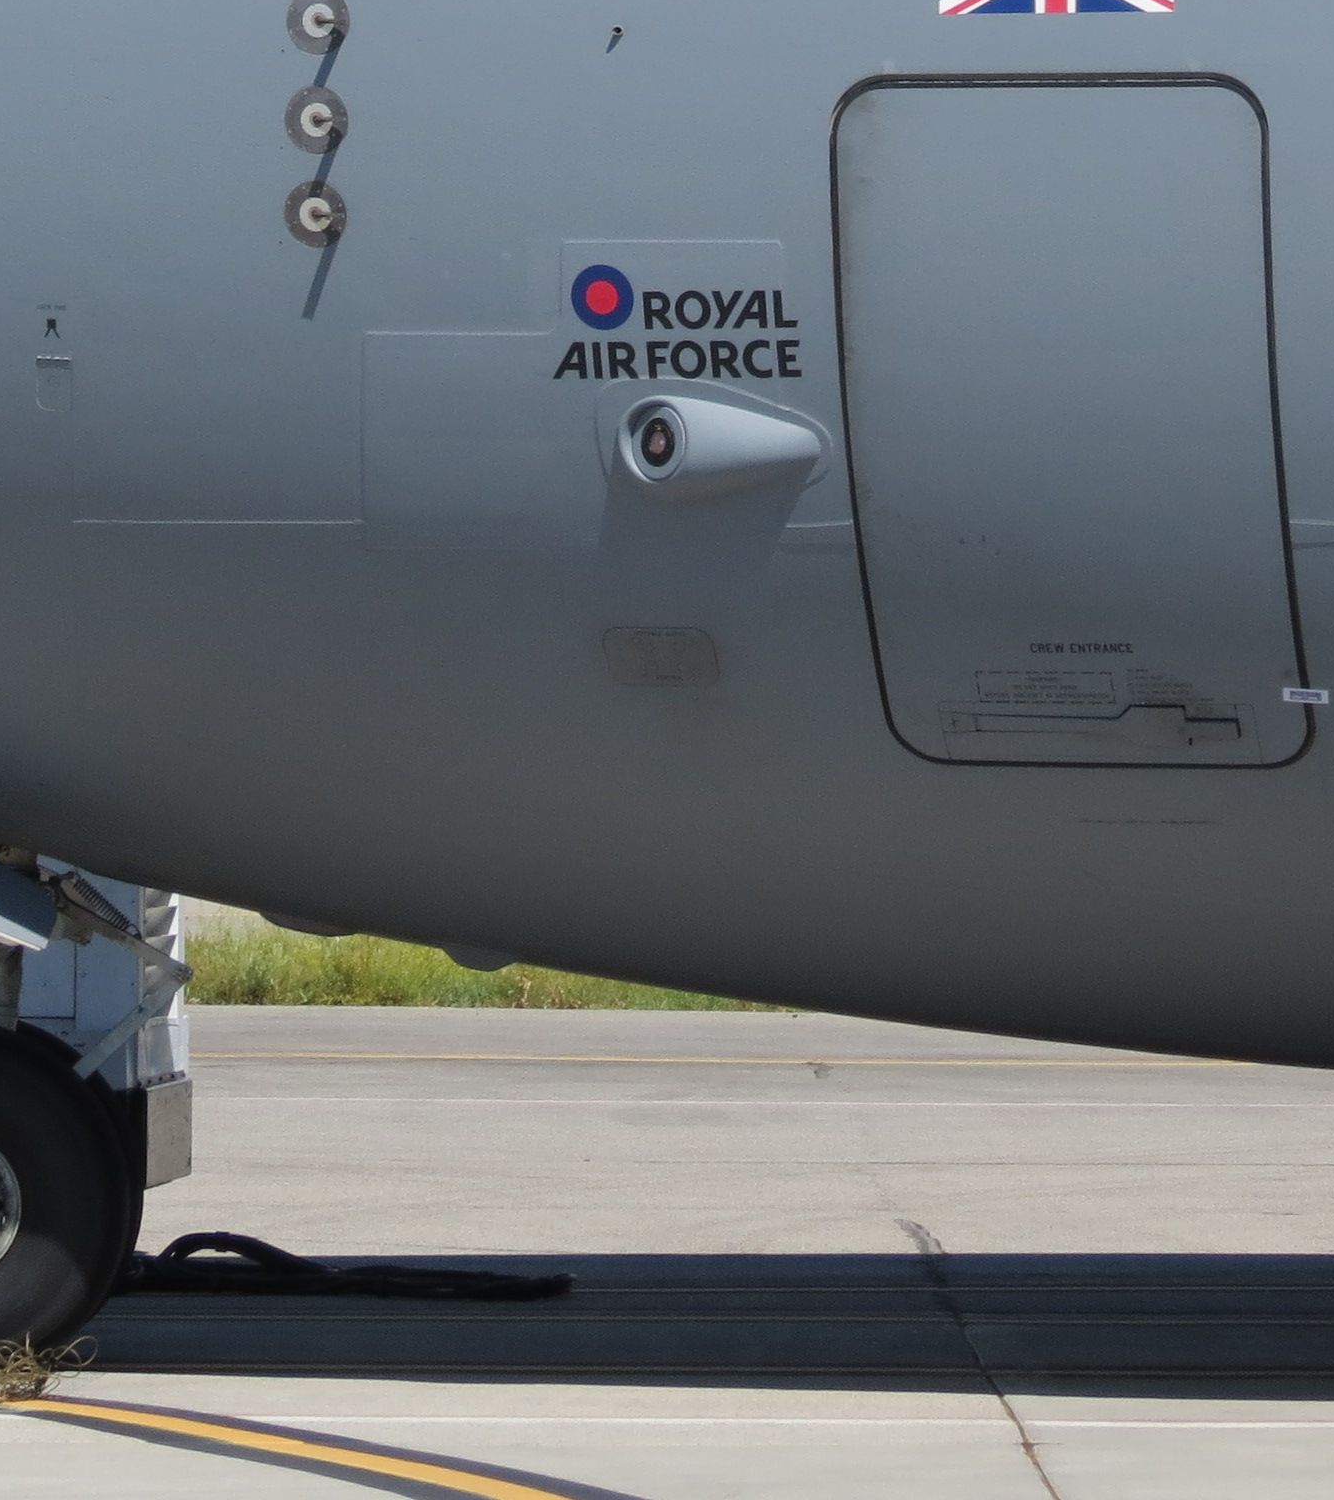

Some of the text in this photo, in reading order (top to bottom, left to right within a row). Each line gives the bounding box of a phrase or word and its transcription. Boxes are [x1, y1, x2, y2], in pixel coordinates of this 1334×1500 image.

[642, 289, 799, 330] ROYAL
[552, 339, 803, 380] AIR FORCE
[1029, 643, 1134, 654] CREW ENTRANCE
